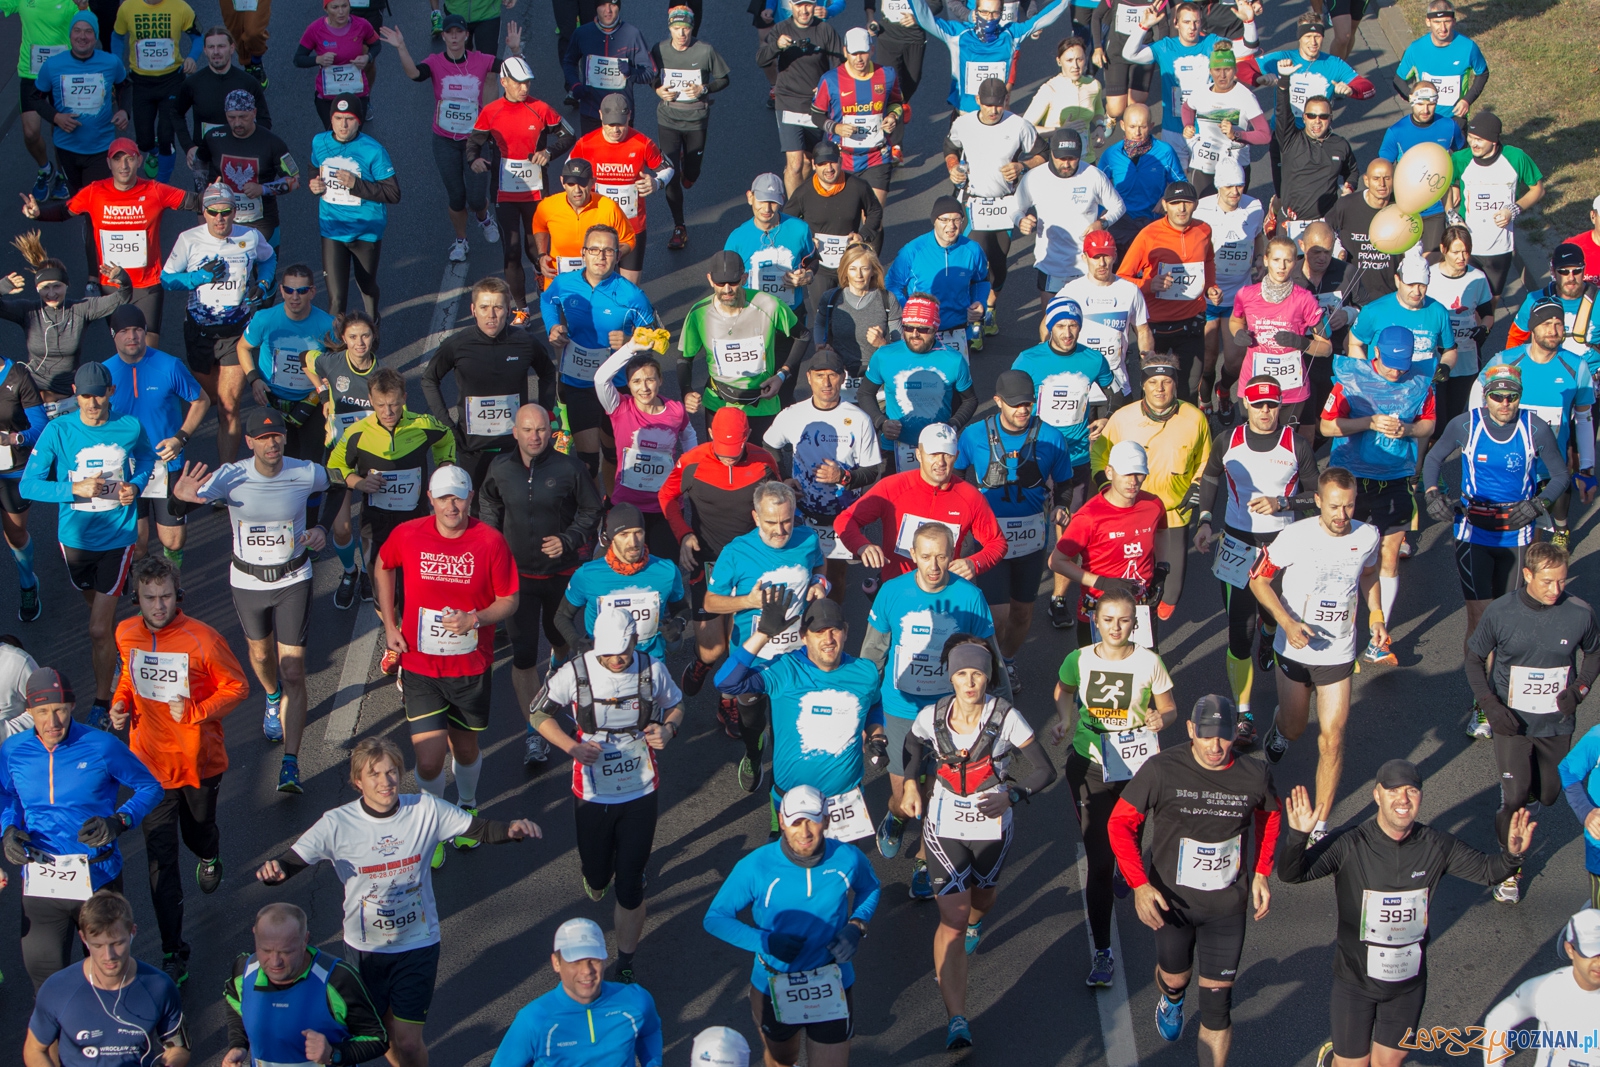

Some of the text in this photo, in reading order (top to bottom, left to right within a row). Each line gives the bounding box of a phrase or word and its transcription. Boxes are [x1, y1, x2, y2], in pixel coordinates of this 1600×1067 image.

[1124, 15, 1140, 24] 341
[142, 48, 168, 57] 5265
[36, 55, 47, 63] 33
[593, 65, 621, 76] 3453
[333, 73, 355, 82] 1272
[70, 85, 97, 95] 2757
[842, 102, 875, 113] unicef
[445, 110, 472, 121] 6655
[1197, 148, 1220, 162] 6261
[511, 169, 532, 179] 740
[325, 179, 347, 191] 454
[609, 195, 630, 205] 961
[1475, 201, 1505, 211] 5347
[977, 206, 1008, 217] 4900
[1350, 233, 1370, 242] JEZU
[108, 242, 140, 253] 2996
[823, 246, 845, 255] 255
[1219, 249, 1248, 261] 3563
[1362, 261, 1390, 270] ŻYCIEM
[209, 280, 238, 291] 7201
[1173, 275, 1197, 286] 407
[762, 283, 786, 293] 604
[1103, 318, 1126, 329] 19.09.15
[572, 354, 601, 369] 1855
[724, 350, 759, 363] 6335
[1263, 364, 1296, 376] 5383
[340, 395, 371, 407] AGATA
[1051, 399, 1079, 410] 2731
[477, 407, 512, 420] 4376
[1269, 458, 1294, 467] TIMEX
[633, 463, 664, 475] 6010
[378, 482, 415, 495] 5467
[246, 534, 287, 547] 6654
[1006, 528, 1036, 542] 2140
[420, 551, 464, 565] DRUŻYNA
[1219, 546, 1247, 567] 7077
[420, 561, 474, 576] SZPIKU
[421, 574, 471, 585] www.darszpiku.pl
[631, 608, 651, 622] 09
[1315, 609, 1349, 622] 3378
[140, 667, 178, 683] 6229
[909, 663, 945, 676] 1754
[1522, 681, 1560, 695] 2328
[1095, 708, 1121, 717] night
[1089, 717, 1127, 726] unners
[1121, 743, 1148, 760] 676
[602, 756, 642, 777] 6487
[830, 805, 855, 823] 615
[954, 811, 986, 822] 268
[1192, 854, 1231, 872] 7325
[39, 865, 77, 882] 2727
[369, 865, 415, 879] 26-28.07.2013
[372, 912, 417, 930] 4998
[1379, 907, 1417, 923] 3931
[786, 983, 833, 1003] 5033
